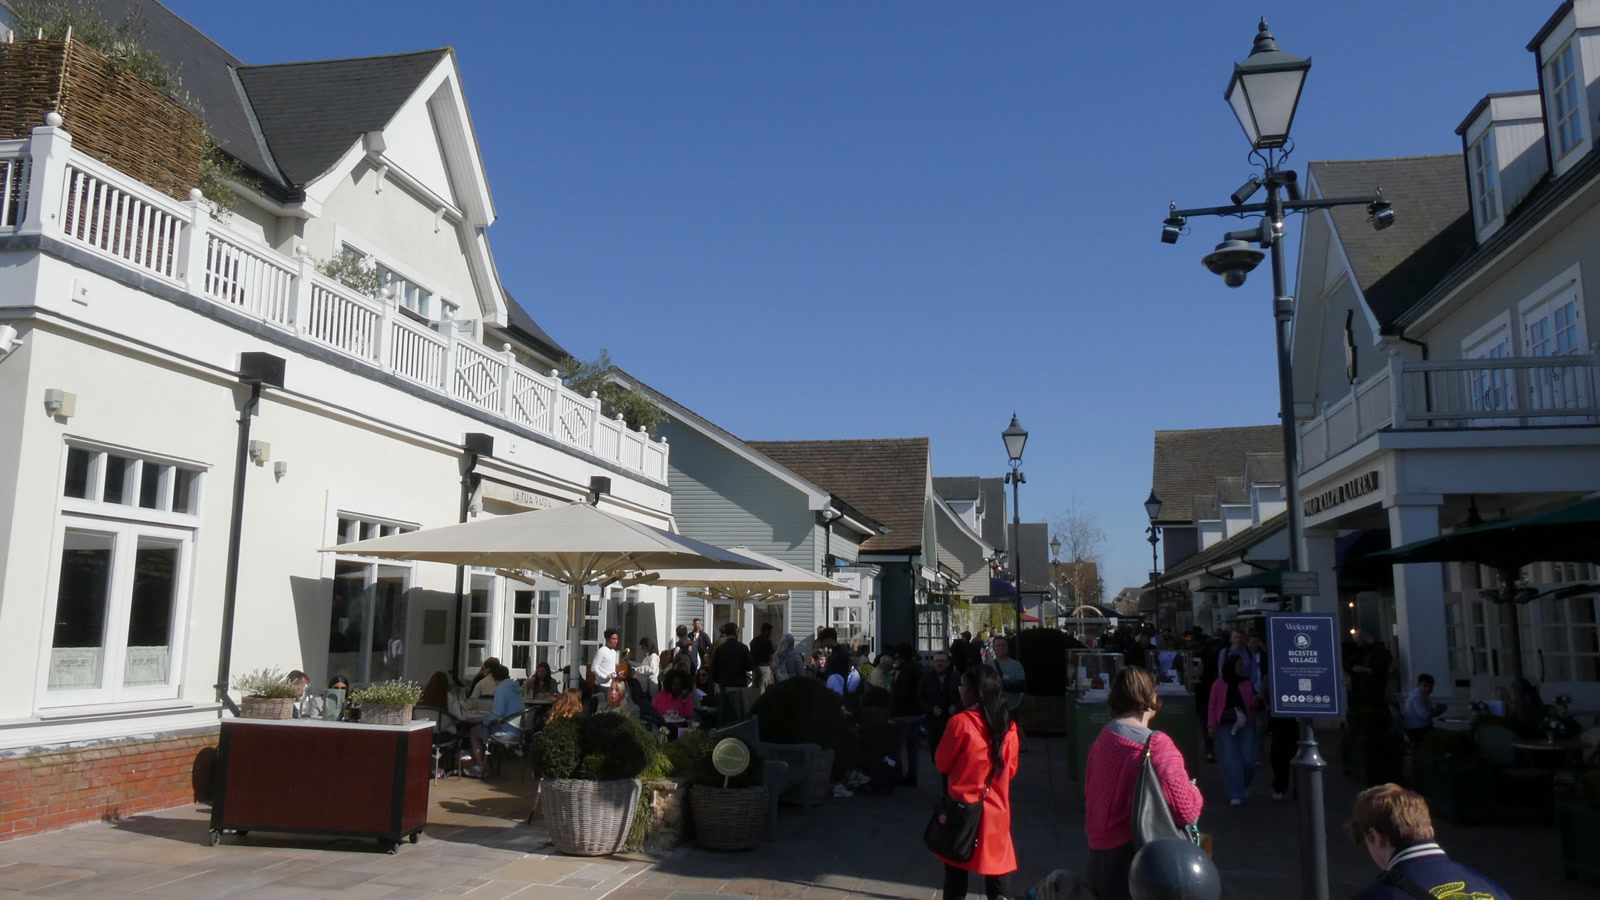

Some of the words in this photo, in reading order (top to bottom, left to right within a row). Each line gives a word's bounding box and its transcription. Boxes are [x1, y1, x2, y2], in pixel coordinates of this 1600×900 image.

[513, 490, 519, 501] LA
[521, 492, 533, 504] TUA
[535, 495, 552, 508] PASTA
[1285, 622, 1319, 631] Welcome
